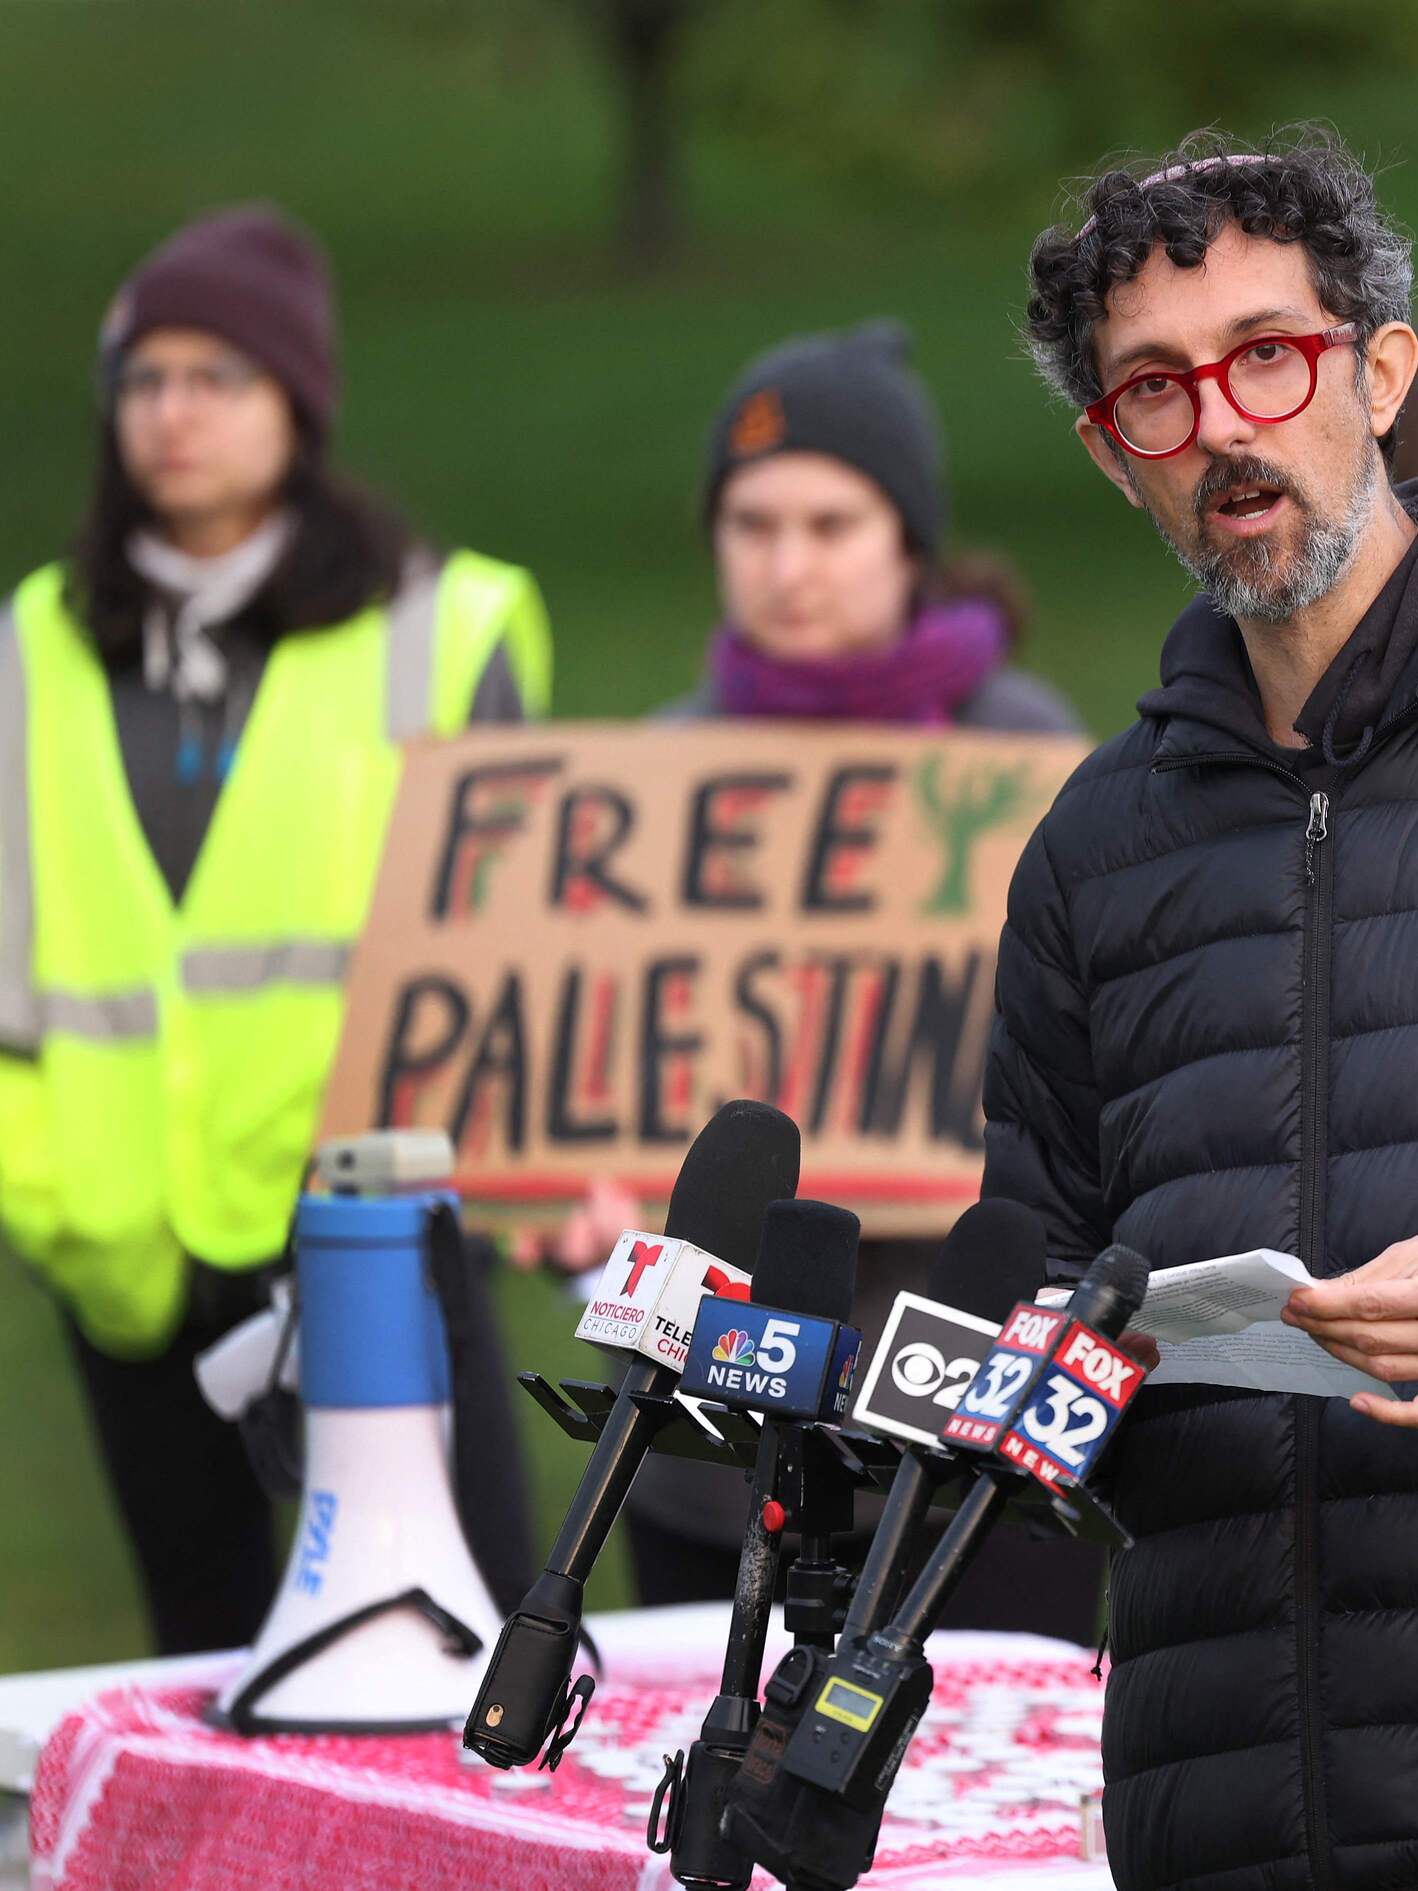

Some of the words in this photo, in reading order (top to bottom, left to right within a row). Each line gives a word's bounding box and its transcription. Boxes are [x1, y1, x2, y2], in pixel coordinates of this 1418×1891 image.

[428, 756, 900, 925] FREE
[583, 1318, 637, 1340] CHICAGO
[590, 1300, 645, 1324] NOTICIERO
[655, 1315, 693, 1347] TELE
[1004, 1310, 1059, 1350] FOX
[657, 1338, 689, 1364] CHI
[756, 1319, 801, 1374] 5
[1062, 1331, 1134, 1400] FOX
[707, 1365, 787, 1398] NEWS
[932, 1358, 981, 1410] 2
[964, 1352, 1033, 1417] 32
[946, 1419, 998, 1443] NEWS
[1023, 1374, 1108, 1468] 32
[1005, 1437, 1062, 1482] NEW
